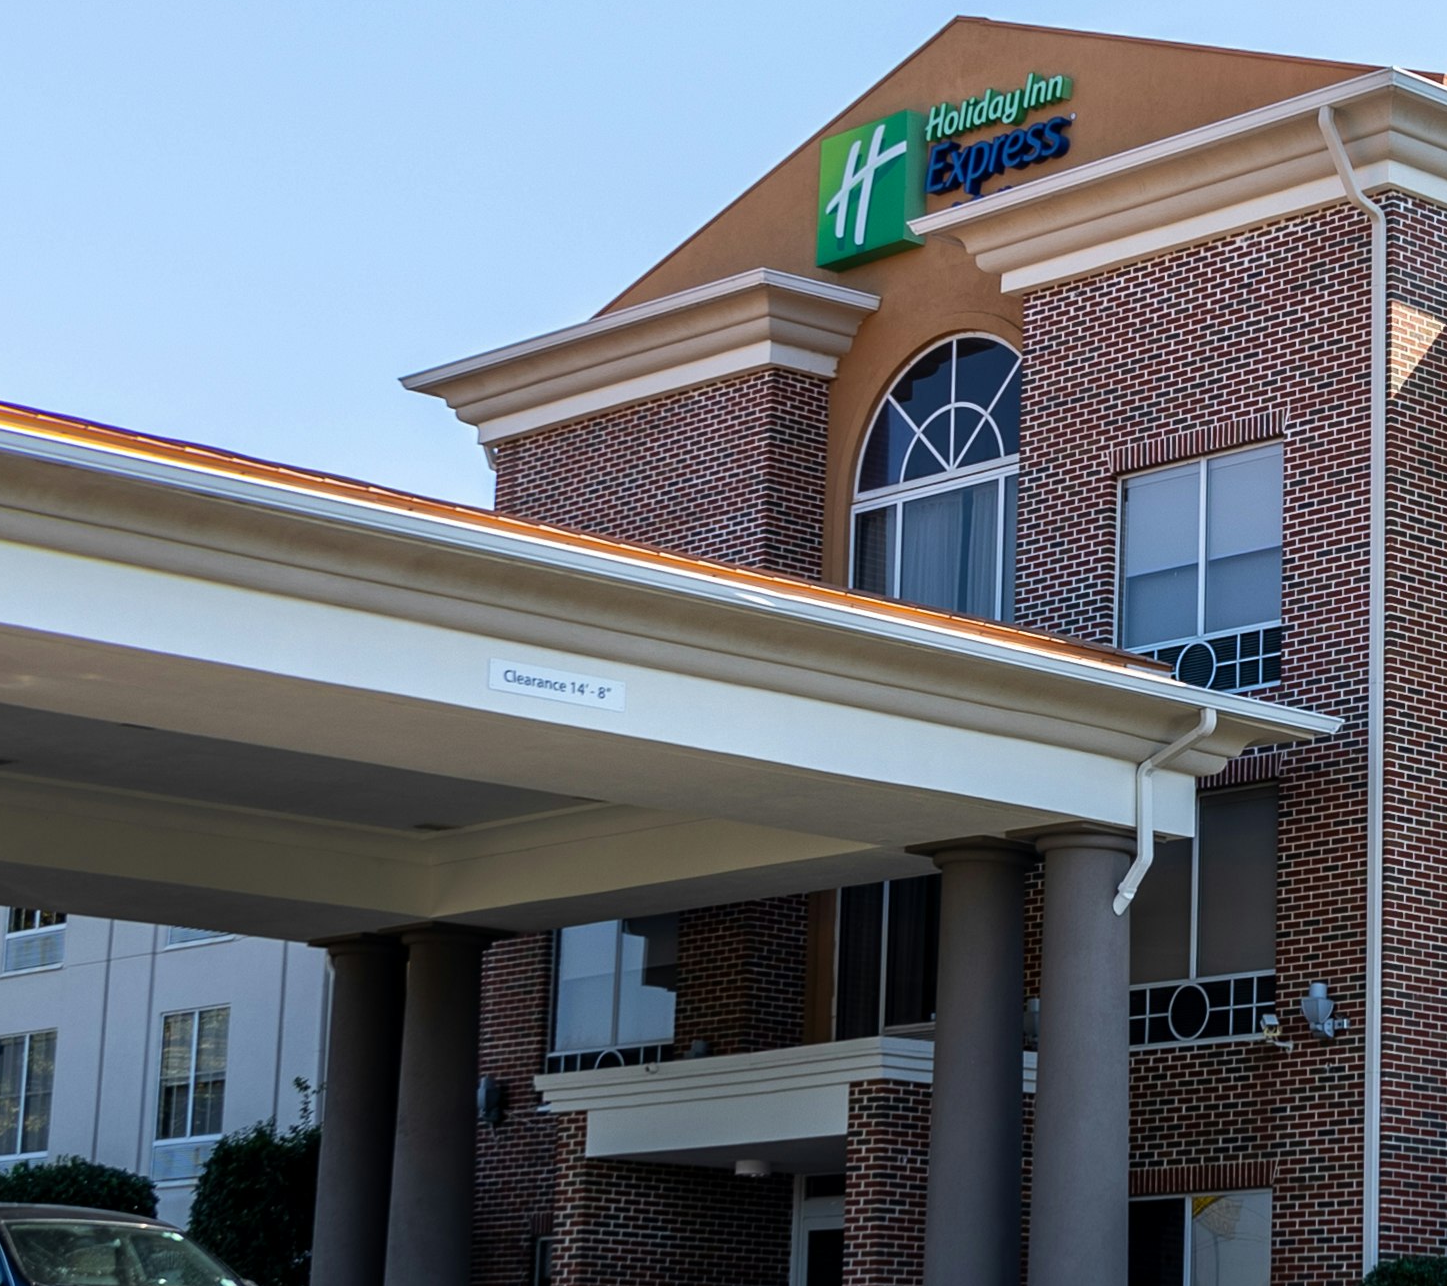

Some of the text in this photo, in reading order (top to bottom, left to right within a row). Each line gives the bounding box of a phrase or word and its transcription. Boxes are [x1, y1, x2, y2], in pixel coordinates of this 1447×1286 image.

[925, 71, 1067, 142] Holiday Inn
[926, 115, 1073, 197] Express
[503, 669, 567, 693] Clearance
